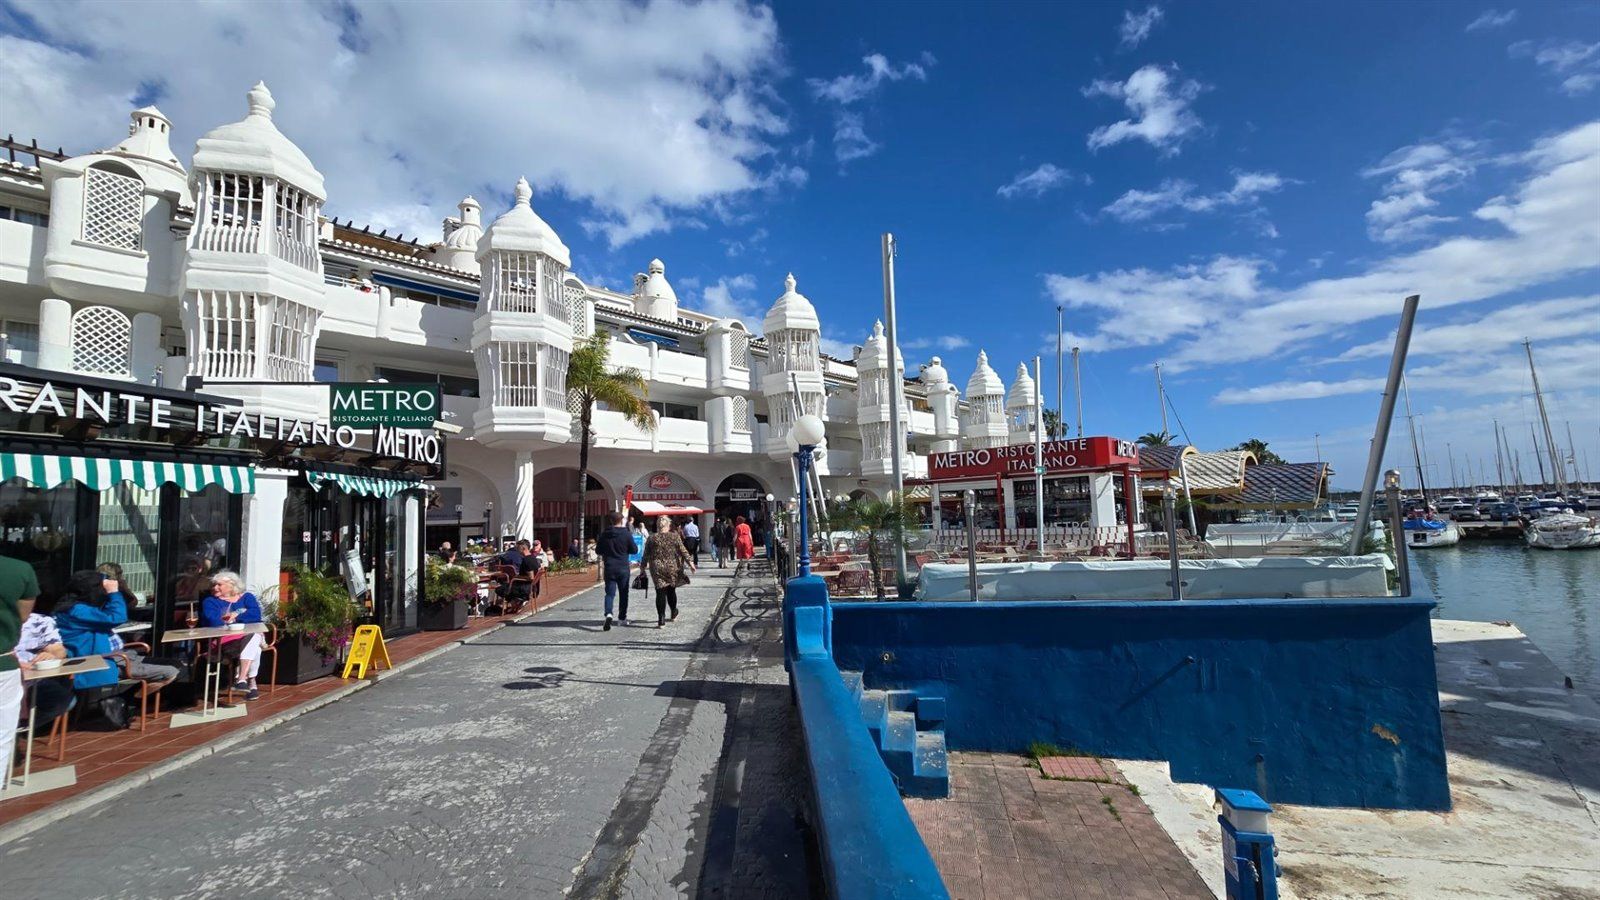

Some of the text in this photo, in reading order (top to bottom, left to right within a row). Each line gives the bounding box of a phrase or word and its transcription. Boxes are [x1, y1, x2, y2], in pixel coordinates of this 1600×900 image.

[332, 389, 435, 411] METRO
[197, 404, 356, 448] ITALIANO
[332, 415, 435, 423] RISTORANTE ITALIANO
[376, 423, 439, 464] METRO
[1117, 440, 1137, 459] METRO
[935, 449, 991, 470] METRO
[1007, 454, 1077, 471] ITALANO
